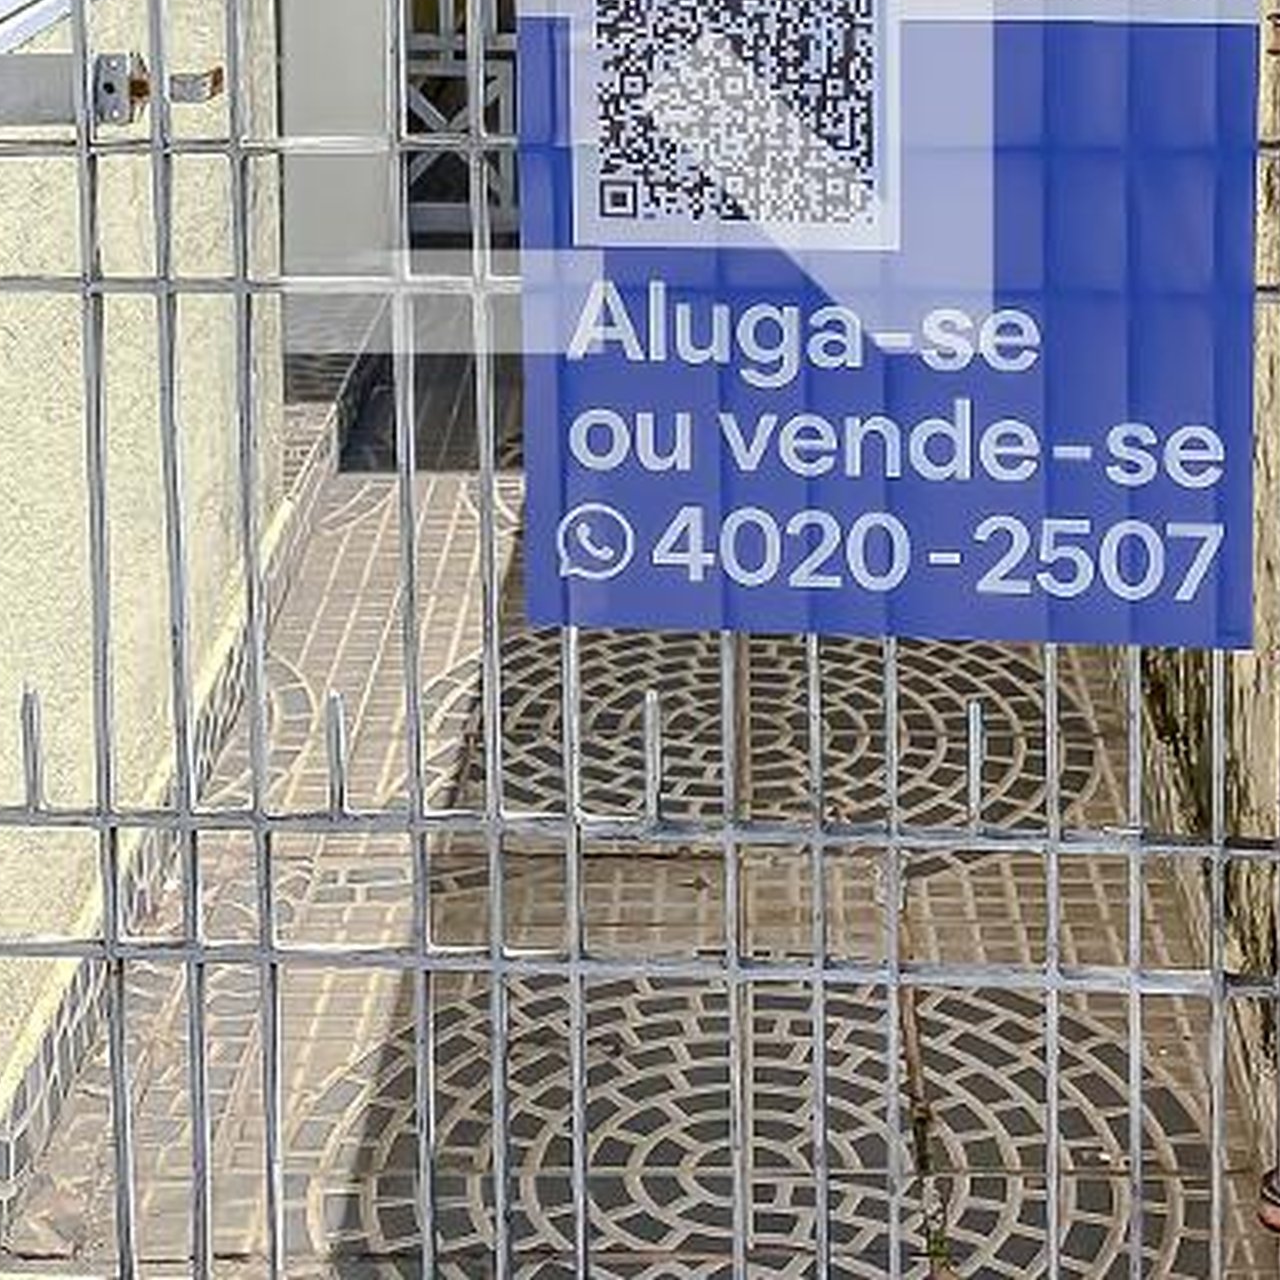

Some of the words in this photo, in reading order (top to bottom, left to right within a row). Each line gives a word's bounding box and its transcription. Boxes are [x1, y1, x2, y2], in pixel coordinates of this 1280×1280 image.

[567, 280, 1041, 389] Aluga-se
[569, 407, 693, 473] ou
[718, 399, 1225, 489] vende-se
[651, 506, 1224, 603] 4020-2507
